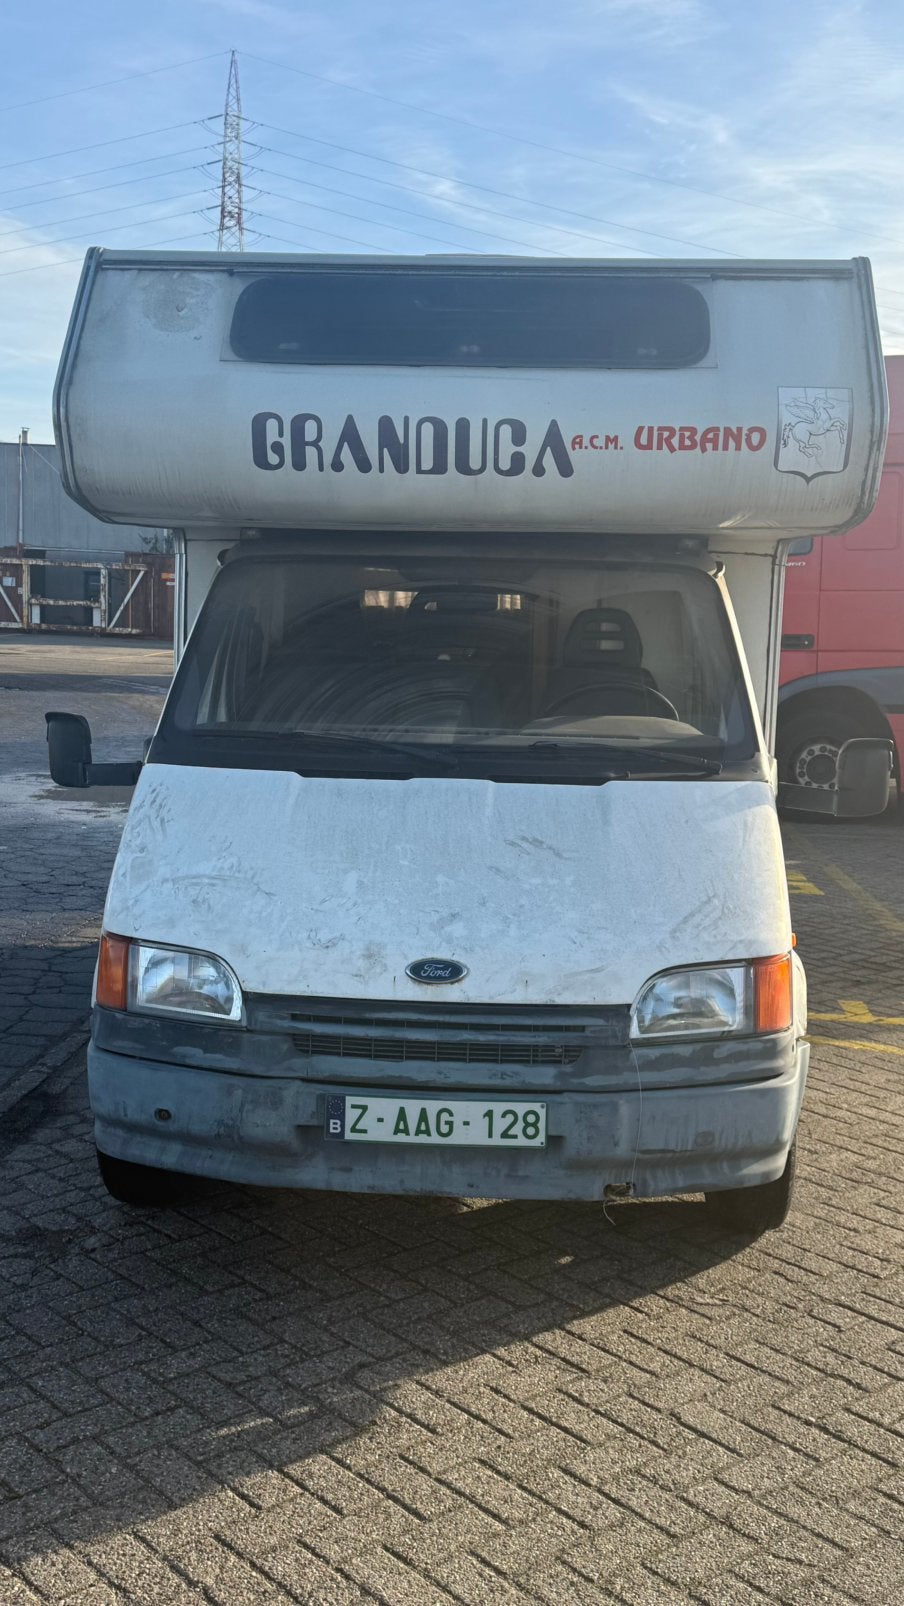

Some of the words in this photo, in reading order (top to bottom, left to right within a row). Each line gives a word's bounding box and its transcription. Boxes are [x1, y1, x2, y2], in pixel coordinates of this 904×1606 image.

[251, 411, 575, 479] GRANDUCA
[571, 434, 624, 451] A.C.M.
[634, 425, 767, 454] URBANO
[420, 963, 452, 977] Ford
[329, 1119, 342, 1134] B
[350, 1103, 541, 1140] Z-AAG-128
